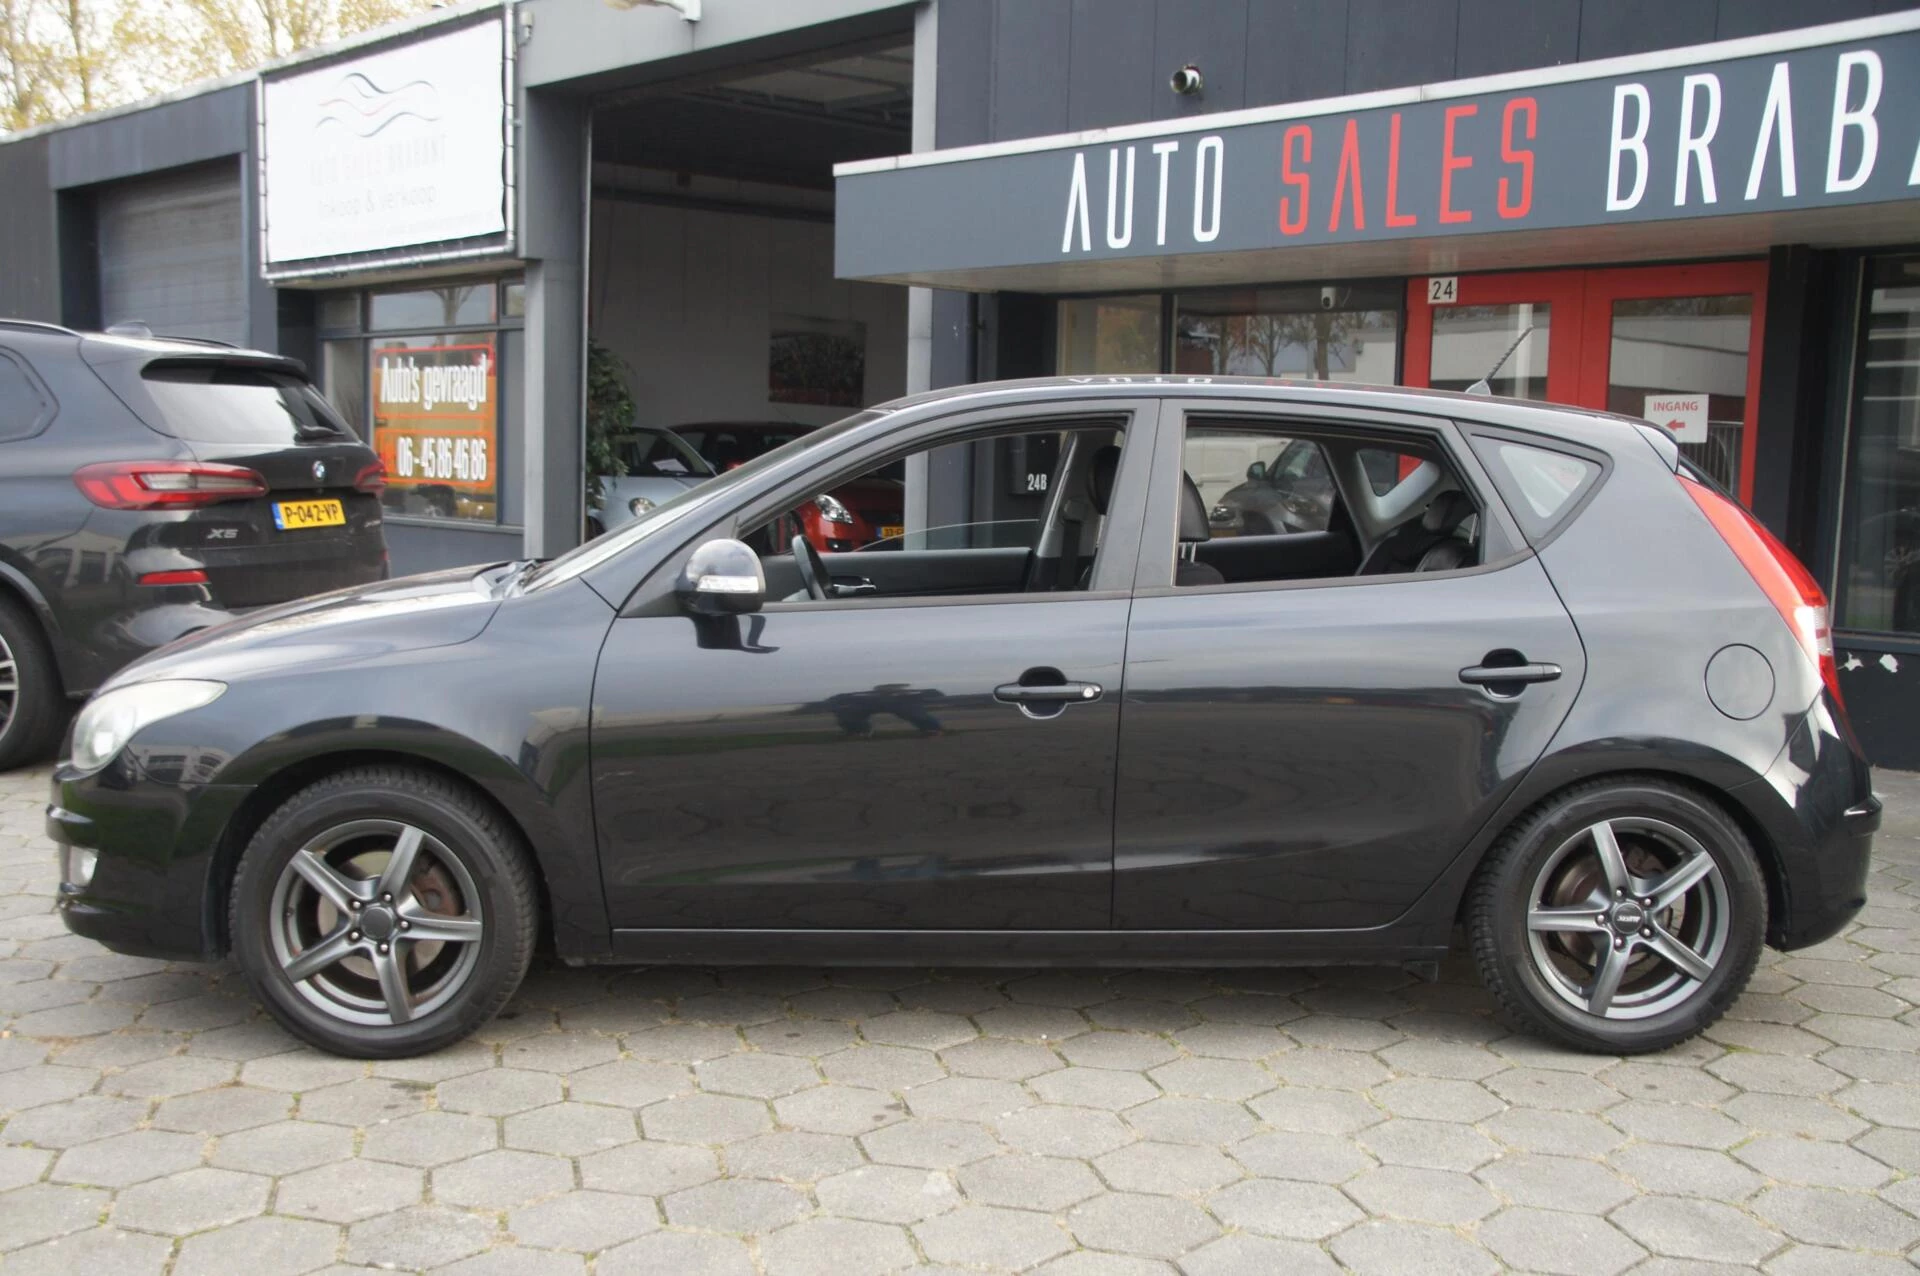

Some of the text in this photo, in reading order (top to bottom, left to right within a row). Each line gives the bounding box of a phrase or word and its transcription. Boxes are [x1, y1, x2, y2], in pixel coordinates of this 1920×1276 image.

[1062, 48, 1920, 253] AUTO SALES BRAB
[1432, 279, 1454, 300] 24
[380, 352, 487, 411] Auto's gevraagd
[1653, 401, 1698, 412] INGANG
[1027, 473, 1047, 490] 24B
[285, 503, 339, 524] P-042-VP
[207, 528, 239, 540] X5
